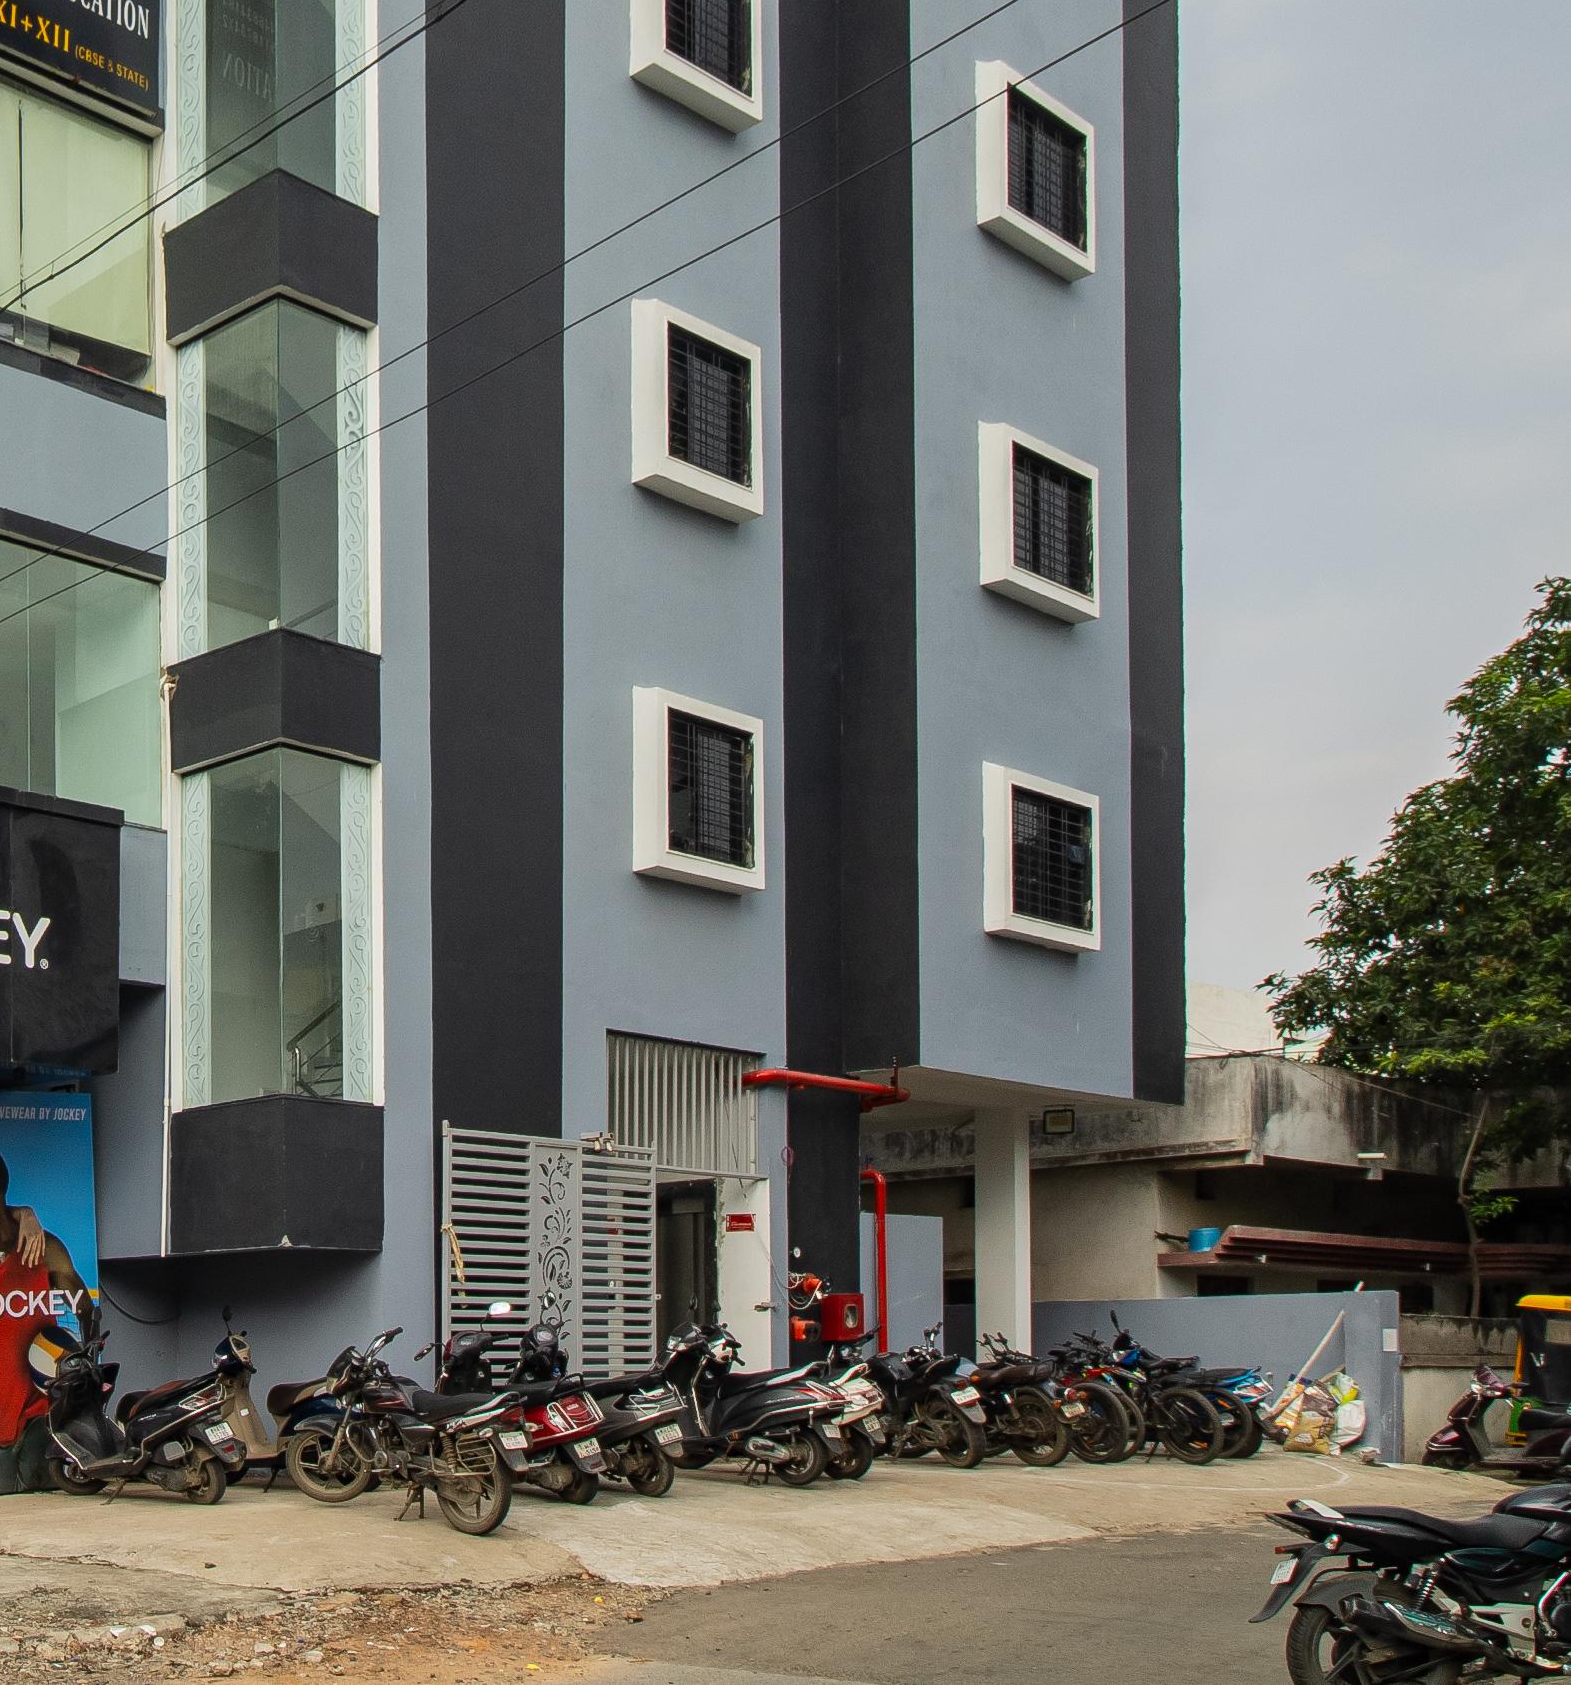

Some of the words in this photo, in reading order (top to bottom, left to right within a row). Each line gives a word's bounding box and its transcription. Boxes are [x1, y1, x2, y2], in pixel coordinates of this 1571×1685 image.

[75, 45, 105, 69] (CBSE
[39, 1107, 50, 1120] BY
[53, 1108, 87, 1121] JOCKEY
